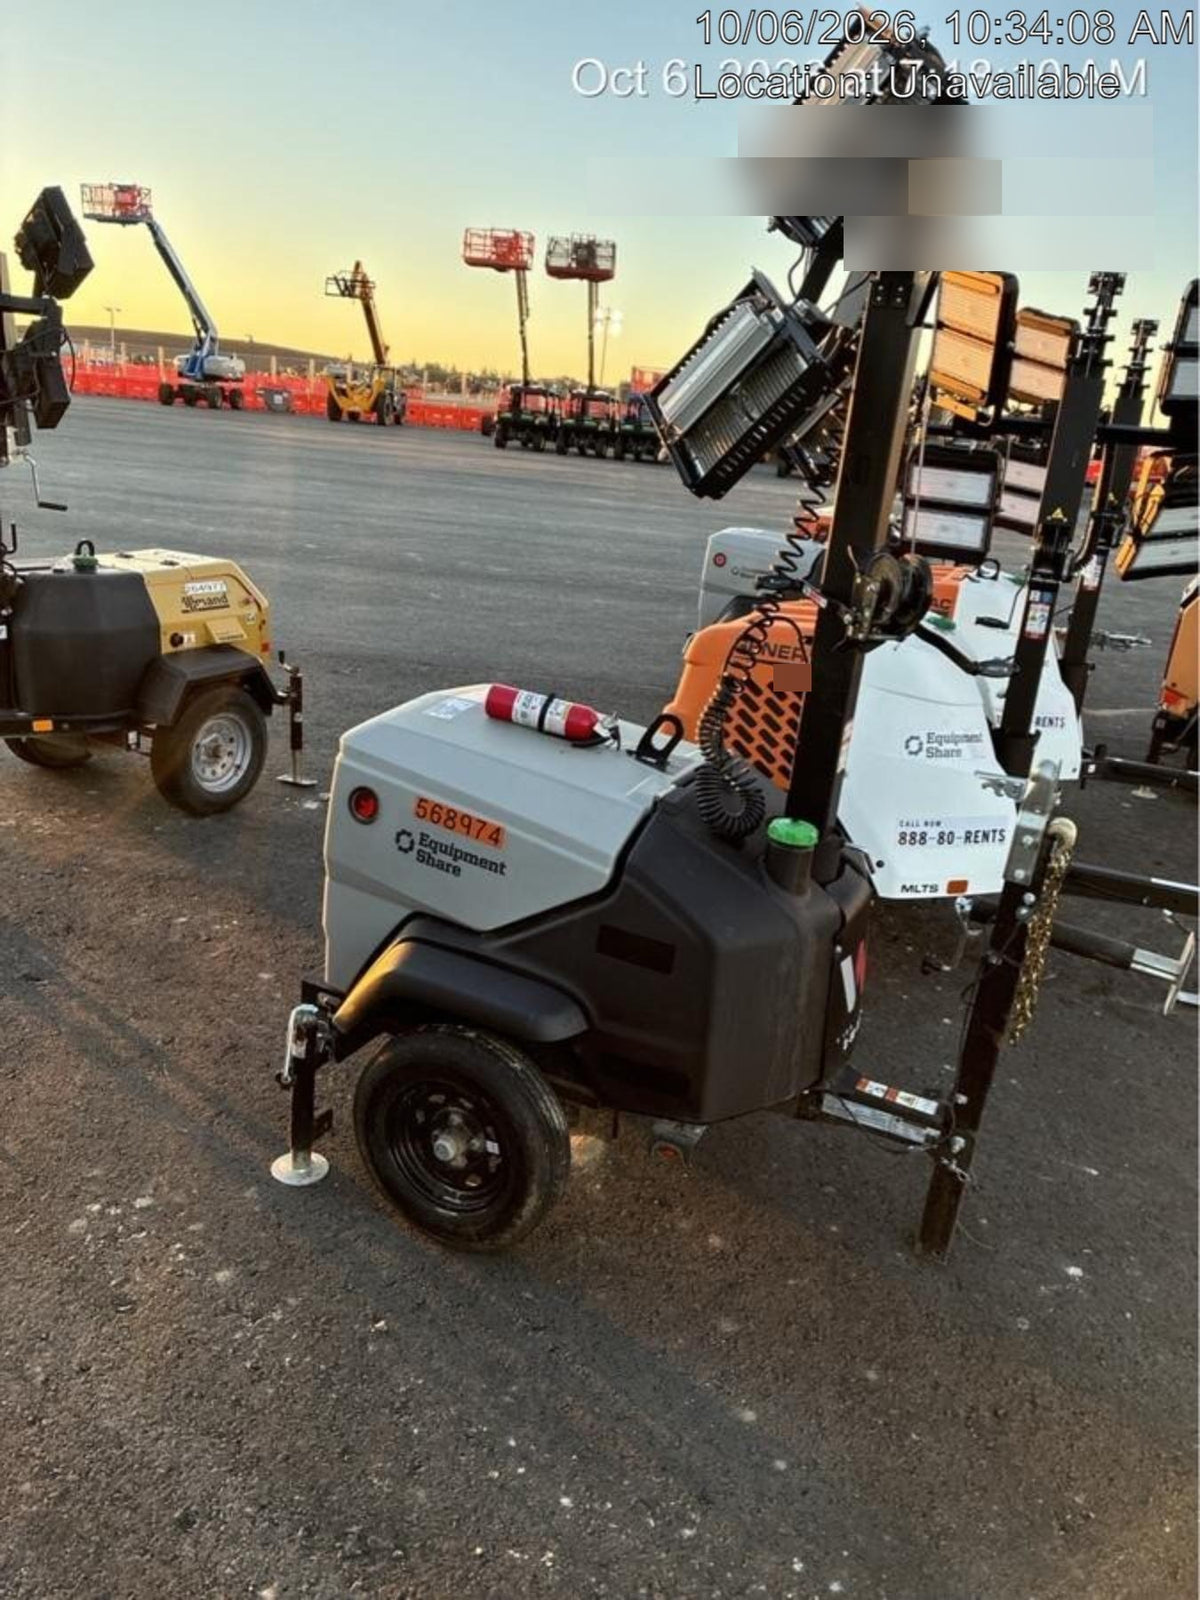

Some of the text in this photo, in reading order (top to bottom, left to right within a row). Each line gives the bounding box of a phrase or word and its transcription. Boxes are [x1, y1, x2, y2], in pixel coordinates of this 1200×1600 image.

[926, 731, 984, 746] Equipment
[926, 746, 963, 758] Share
[414, 797, 503, 847] 568974
[898, 828, 1007, 846] 888-80-RENTS
[416, 849, 461, 878] Share
[418, 832, 507, 876] Equipment
